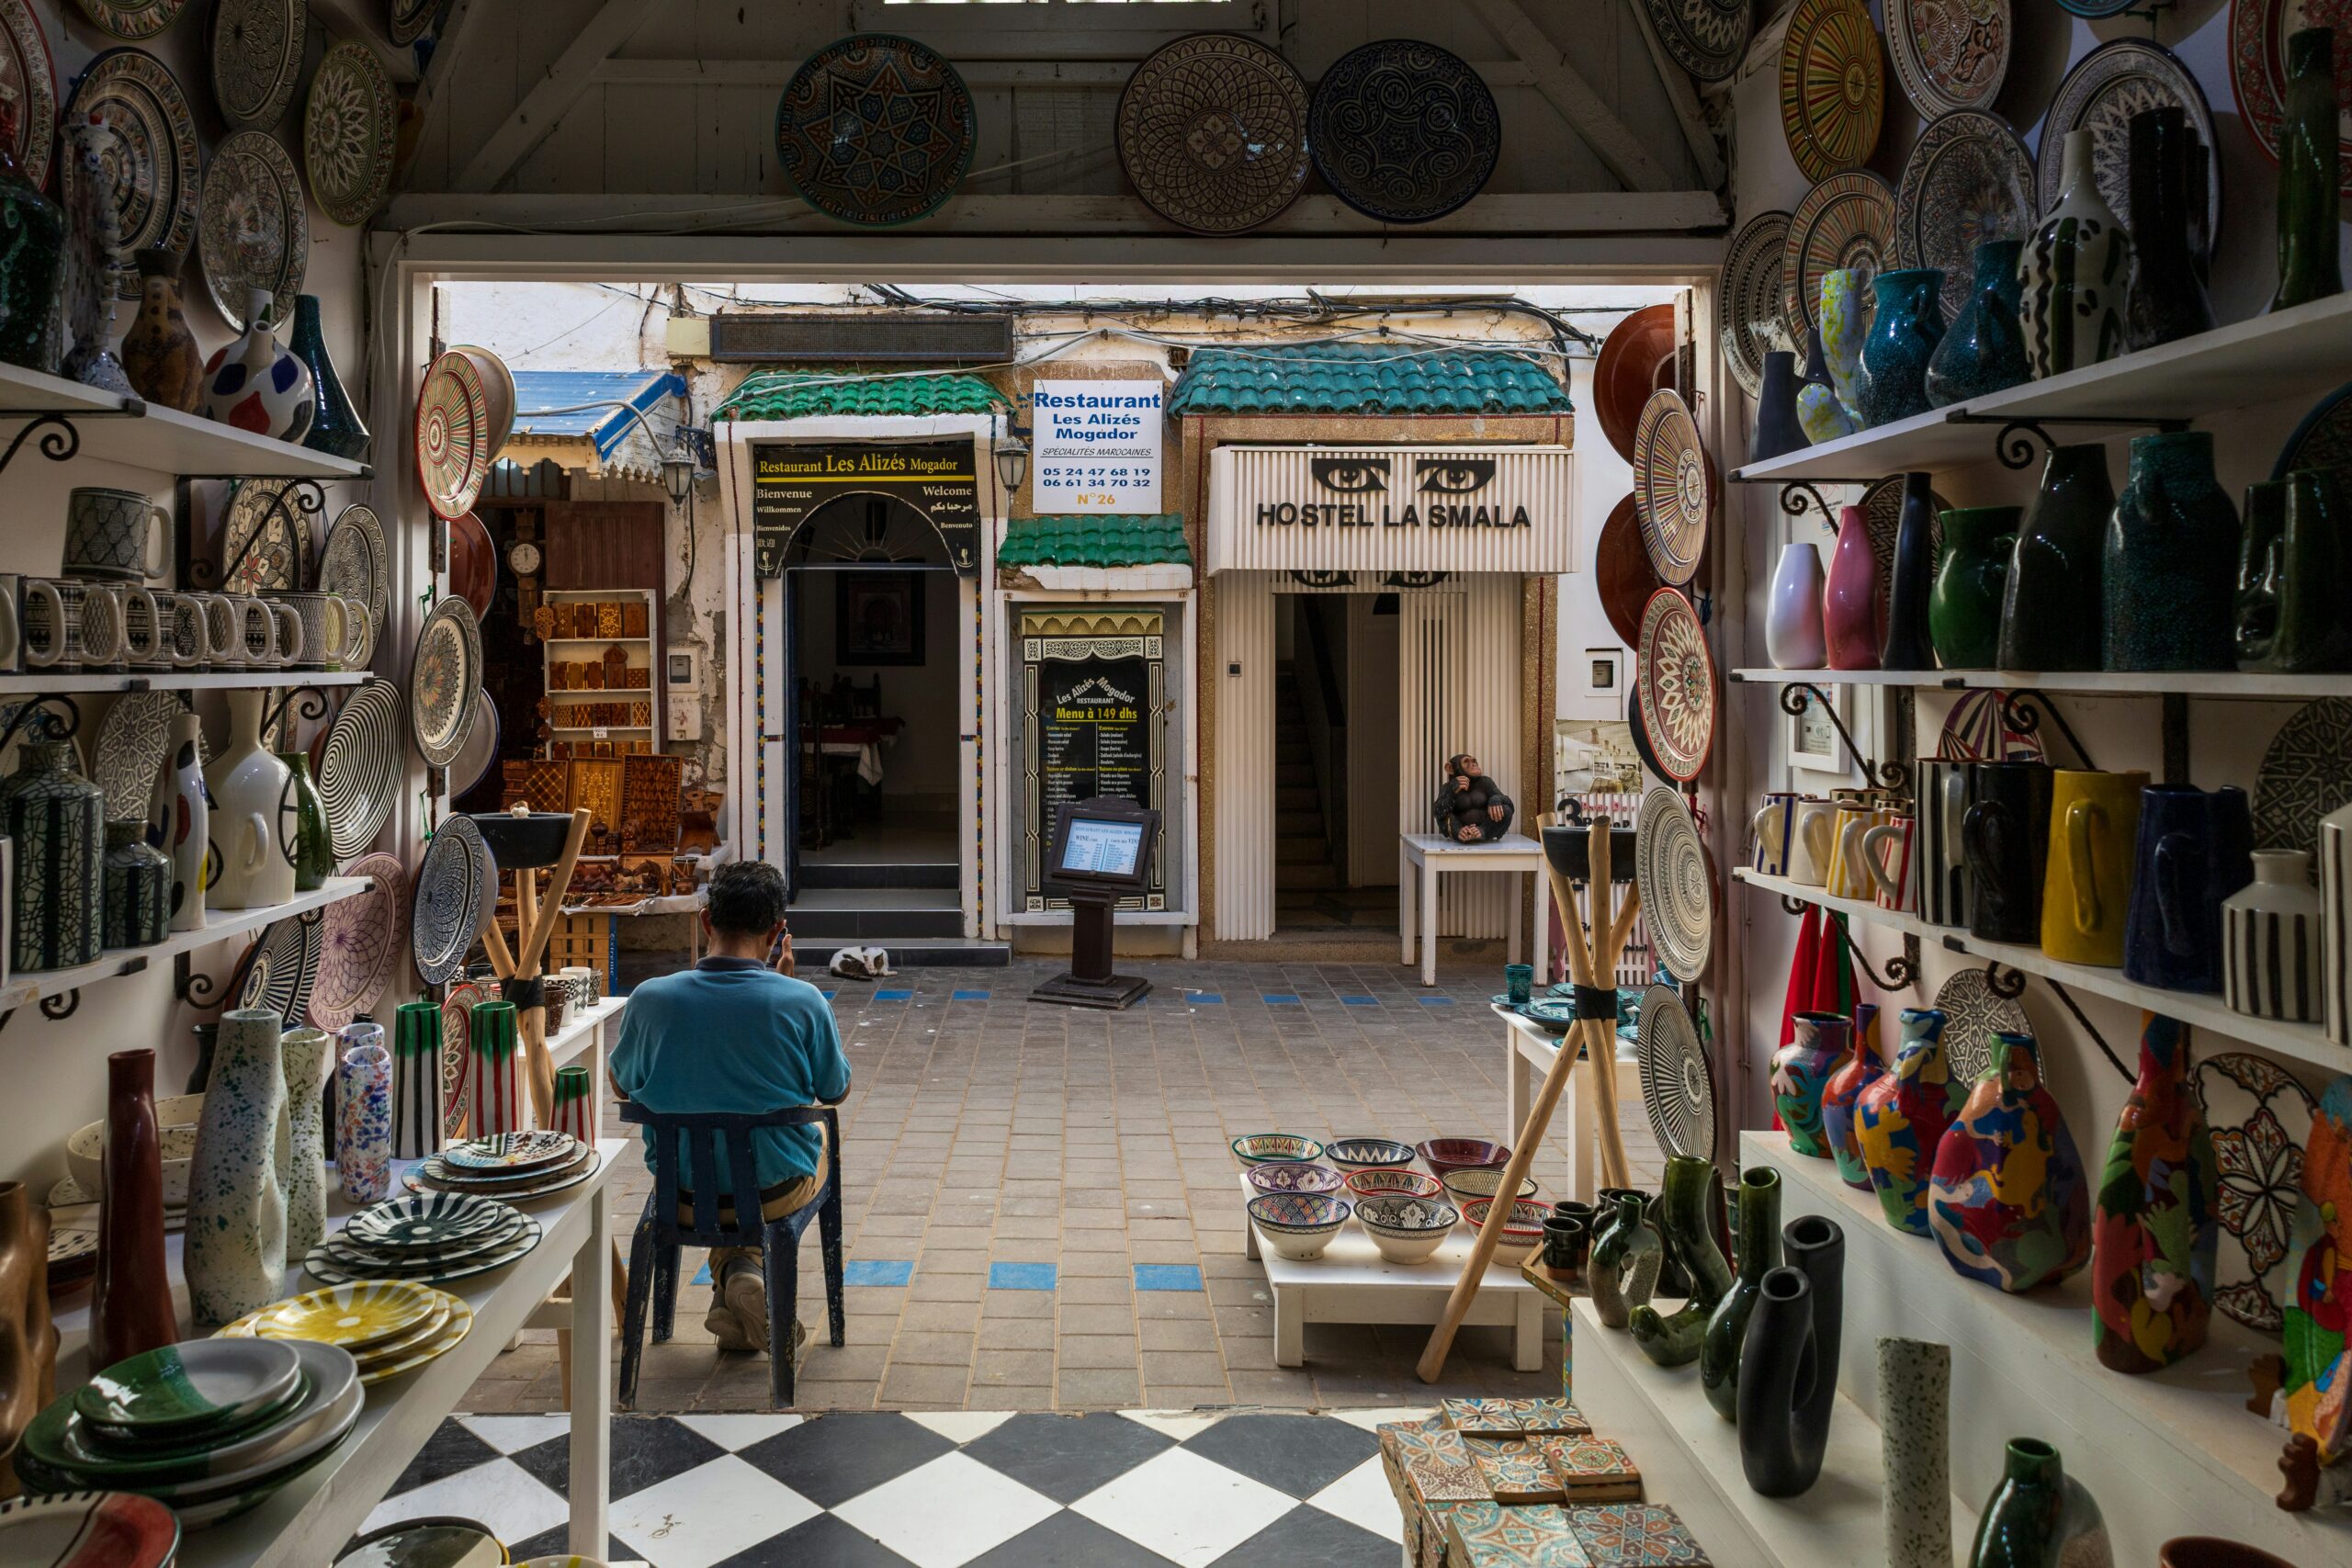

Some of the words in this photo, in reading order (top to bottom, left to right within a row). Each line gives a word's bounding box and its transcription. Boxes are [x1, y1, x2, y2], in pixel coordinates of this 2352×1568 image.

[1035, 392, 1161, 409] Restaurant
[1053, 414, 1081, 424] Les
[1088, 413, 1140, 424] Alizés
[1056, 428, 1138, 442] Mogador
[1042, 446, 1095, 456] SPÉCIALITÉS
[760, 460, 822, 473] Restaurant
[826, 455, 854, 472] Les
[858, 453, 906, 472] Alizés
[910, 457, 958, 474] Mogador
[1043, 468, 1060, 476] 05
[1066, 468, 1083, 476] 24
[1088, 468, 1105, 476] 47
[1110, 468, 1127, 476] 68
[1134, 468, 1150, 476] 19
[1043, 479, 1060, 487] 06
[1066, 479, 1081, 487] 61
[1088, 479, 1105, 487] 34
[1111, 479, 1127, 487] 70
[1133, 479, 1150, 487] 32
[757, 489, 812, 499] Bienvenue
[922, 485, 972, 496] Welcome
[931, 502, 945, 513] بكم
[946, 502, 973, 513] مرحبا
[1256, 502, 1374, 527] HOSTEL
[1383, 505, 1421, 528] LA
[1428, 504, 1532, 529] SMALA
[1056, 694, 1071, 705] Les
[1071, 678, 1095, 698] Alizés
[1096, 676, 1136, 704] Mogador
[1056, 707, 1084, 718] Menu
[1088, 707, 1094, 718] à
[1098, 707, 1116, 718] 149
[1119, 706, 1137, 718] dhs
[1557, 798, 1583, 827] 3
